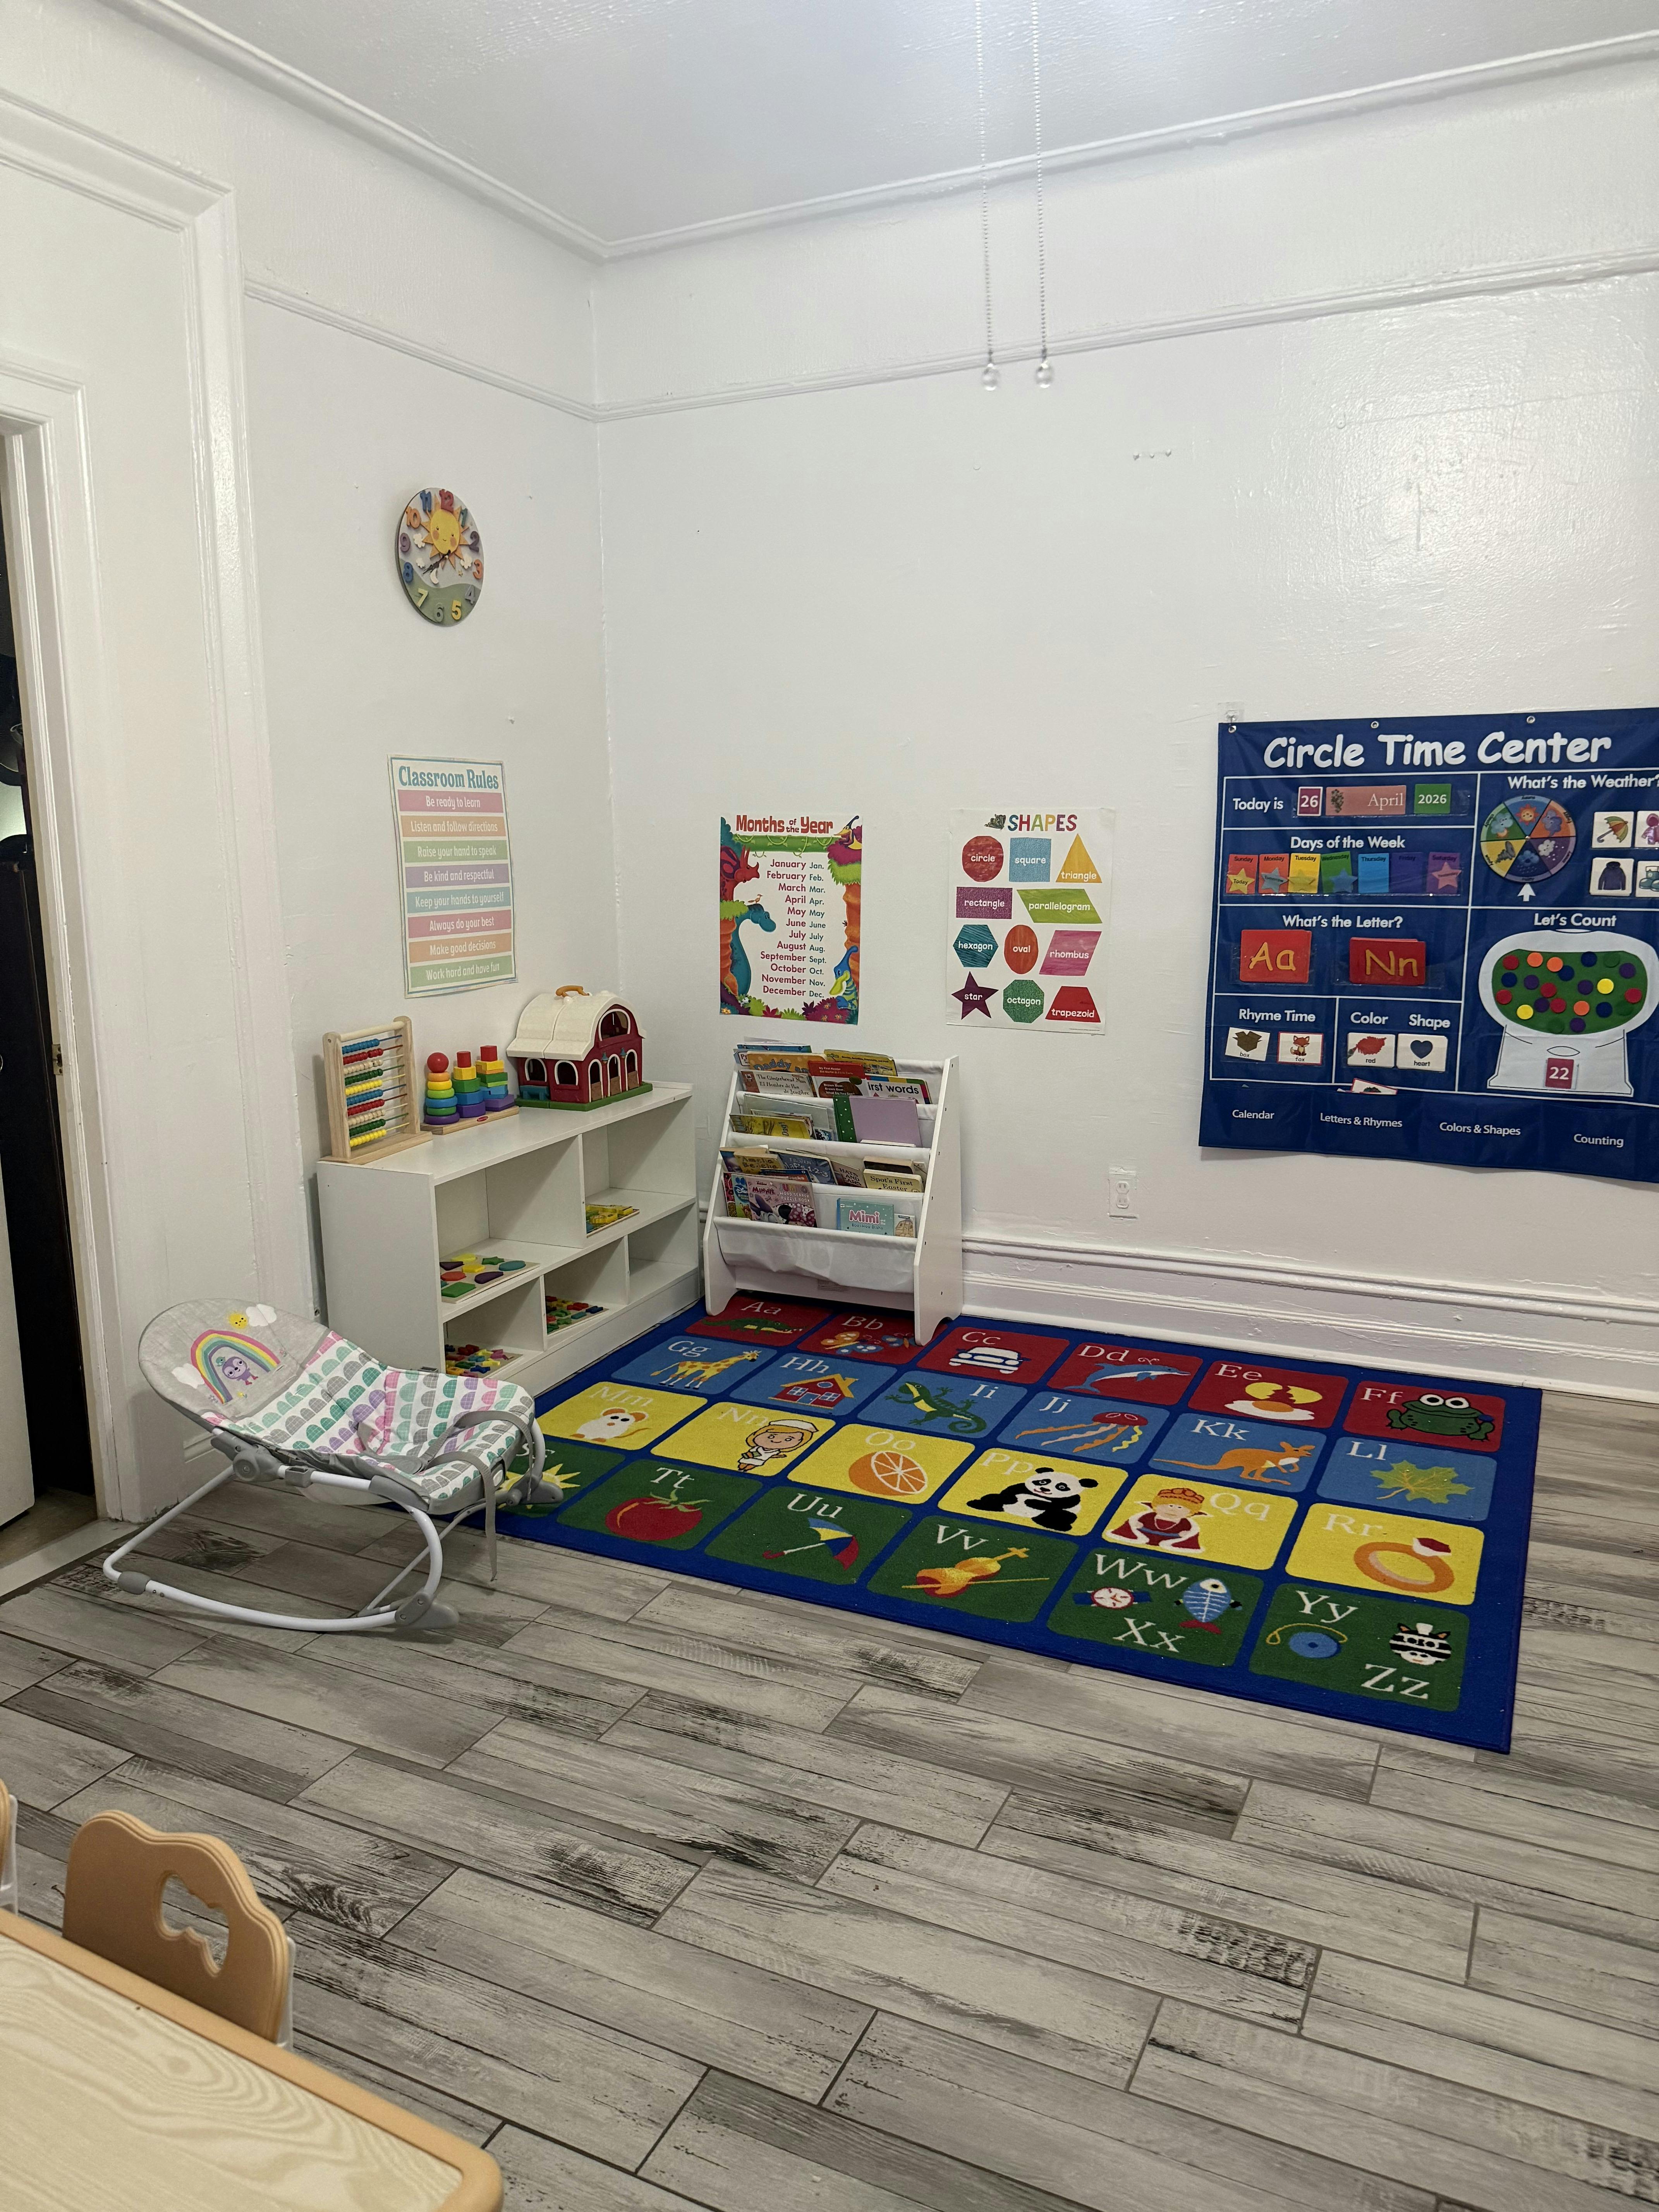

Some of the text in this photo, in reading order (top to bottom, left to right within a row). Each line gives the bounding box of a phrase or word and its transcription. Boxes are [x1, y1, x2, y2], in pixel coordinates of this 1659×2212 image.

[469, 531, 479, 551] 2
[404, 562, 413, 582] 8
[473, 559, 483, 579] 3
[452, 600, 461, 620] 5
[1264, 731, 1611, 768] Circle Time Center
[399, 766, 499, 789] Classroom Rules
[1508, 776, 1558, 789] What's
[1563, 776, 1586, 789] the
[426, 795, 480, 809] Be ready to learn
[1233, 797, 1283, 812] Today is
[1301, 795, 1318, 807] 26
[1367, 793, 1403, 810] April
[1418, 794, 1447, 804] 2026
[411, 821, 498, 832] Listen and follow directions
[736, 815, 785, 832] Months
[800, 817, 833, 833] Year
[1008, 814, 1077, 832] SHAPES
[1291, 836, 1405, 851] Days of the Week
[418, 846, 496, 859] Raise your hand to speak
[770, 859, 806, 870] January
[1015, 857, 1046, 865] square
[424, 869, 494, 882] Be kind and respectful
[767, 871, 806, 882] February
[1061, 872, 1097, 882] triangle
[778, 883, 806, 891] March
[416, 892, 504, 909] Keep your hands to yourself
[785, 895, 806, 905] April
[964, 900, 1005, 908] rectangle
[1029, 902, 1090, 911] parallelogram
[787, 907, 824, 918] May May
[430, 917, 494, 932] Always do your best
[786, 919, 806, 927] June
[1282, 915, 1402, 928] What's the Letter?
[1534, 913, 1616, 927] Let's Count
[789, 930, 823, 941] July July
[430, 940, 496, 956] Make good decisions
[777, 941, 825, 953] August Aug.
[958, 942, 993, 951] hexagon
[761, 951, 826, 964] September Sept.
[1050, 951, 1089, 959] rhombus
[1249, 943, 1296, 971] Aa
[771, 963, 806, 973] October
[1365, 950, 1418, 976] Nn
[426, 962, 499, 980] Work hard and have fun
[762, 974, 806, 984] November
[763, 986, 806, 996] December
[1007, 997, 1041, 1006] octagon
[1051, 1008, 1095, 1018] trapezoid
[1239, 1009, 1316, 1023] Rhyme Time
[1350, 1012, 1388, 1025] Color
[1409, 1014, 1451, 1030] Shape
[754, 1059, 792, 1070] Daddy
[1549, 1067, 1569, 1080] 22
[886, 1085, 919, 1094] words
[1232, 1110, 1274, 1119] Calendar
[1320, 1113, 1352, 1124] Letters
[1364, 1117, 1402, 1128] Rhymes
[1439, 1122, 1471, 1133] Colors
[1484, 1125, 1521, 1135] Shapes
[1574, 1134, 1624, 1148] Counting
[808, 1166, 828, 1177] 1-2-3
[849, 1209, 880, 1224] Mimi
[742, 1302, 781, 1316] Aa
[841, 1316, 883, 1330] Bb
[962, 1332, 1001, 1345] Cc
[668, 1340, 711, 1358] Gg
[1077, 1345, 1130, 1363] Dd
[780, 1357, 830, 1373] Hh
[1214, 1364, 1263, 1381] Ee
[970, 1384, 1001, 1400] Ii
[1361, 1388, 1403, 1405] Ff
[1039, 1397, 1070, 1414] Jj
[1191, 1419, 1250, 1441] Kk
[1347, 1441, 1387, 1461] Ll
[651, 1467, 695, 1489] Tt
[787, 1493, 844, 1518] Uu
[936, 1524, 989, 1551] Vv
[1094, 1553, 1189, 1589] Ww
[1295, 1590, 1358, 1623] Yy
[1113, 1617, 1185, 1653] Xx
[1361, 1663, 1430, 1699] Zz
